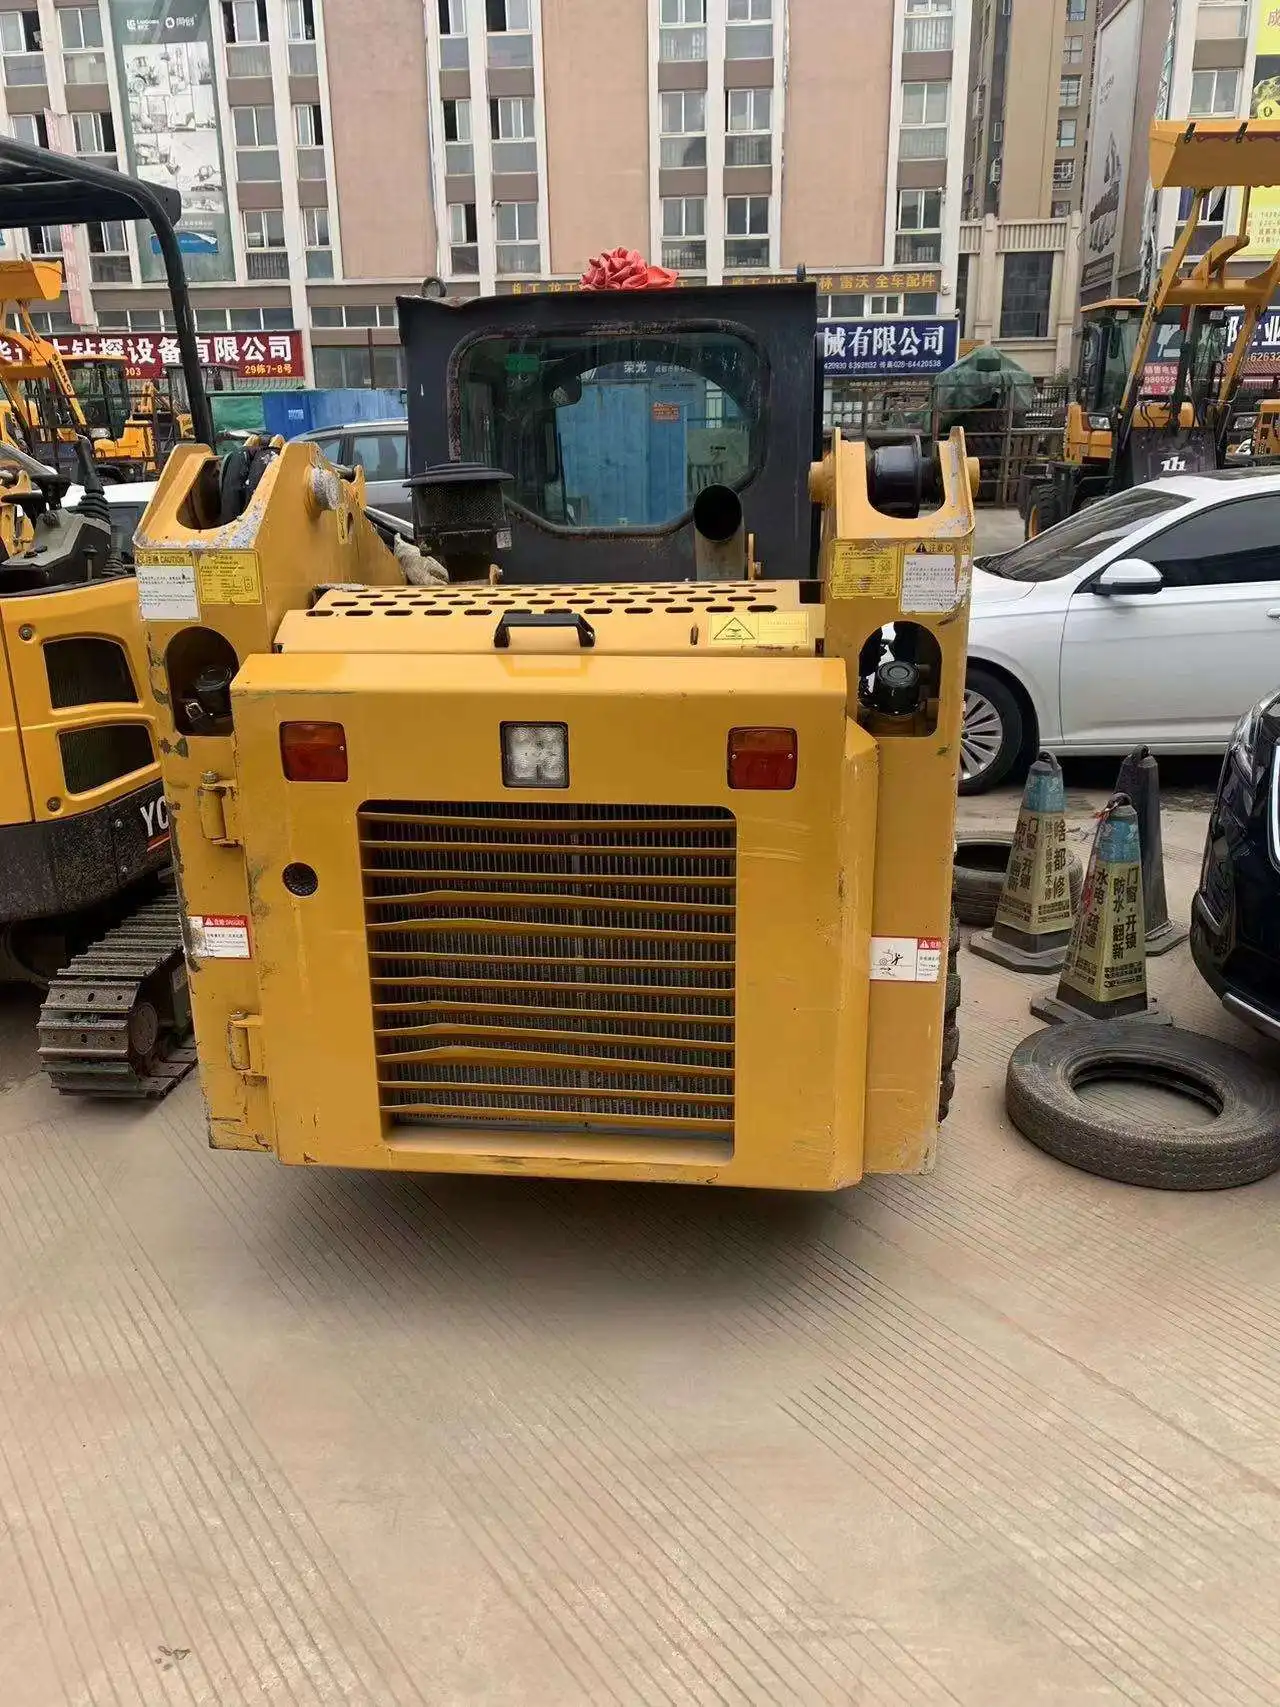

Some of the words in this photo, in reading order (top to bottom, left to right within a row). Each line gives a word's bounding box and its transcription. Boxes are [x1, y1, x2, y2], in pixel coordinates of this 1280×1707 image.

[824, 325, 945, 357] 械有限公司
[624, 361, 647, 374] 荣光
